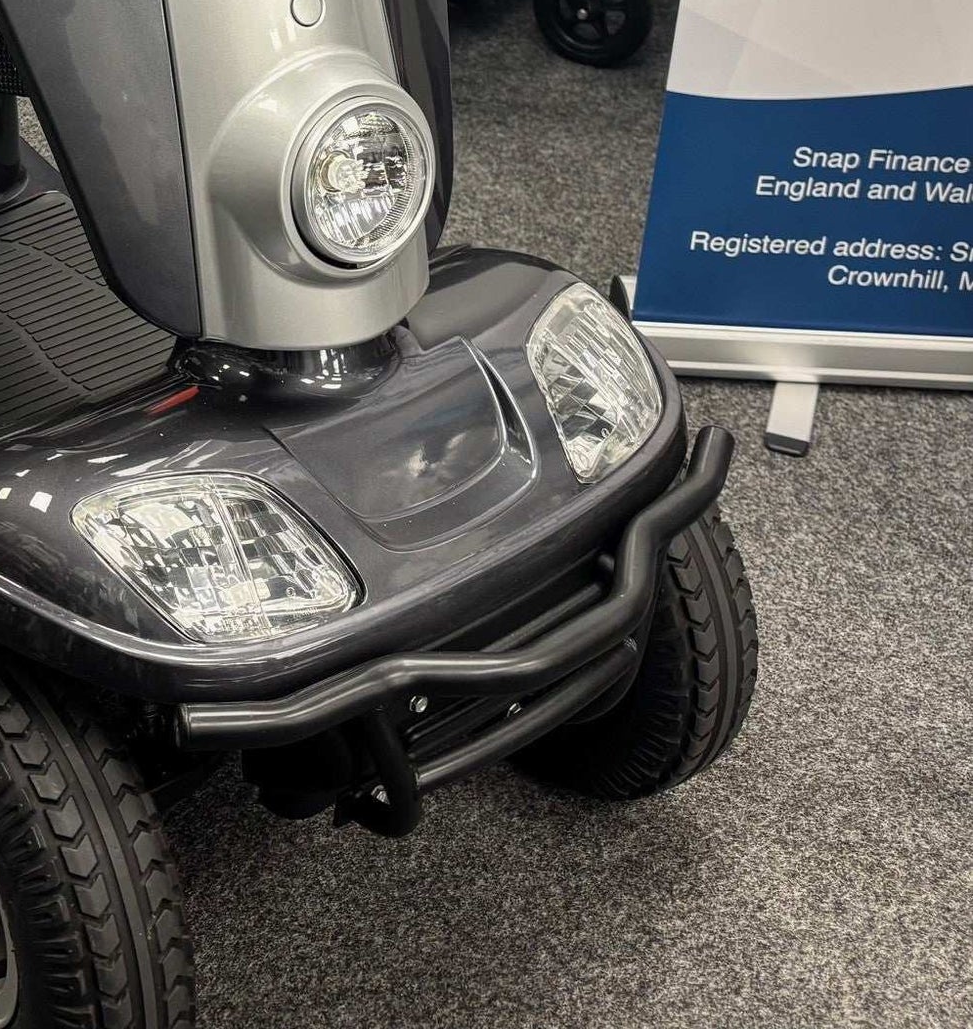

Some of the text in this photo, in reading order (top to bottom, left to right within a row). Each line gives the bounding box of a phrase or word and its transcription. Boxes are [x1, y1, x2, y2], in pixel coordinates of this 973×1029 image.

[793, 146, 971, 174] Snap Finance
[755, 175, 973, 205] England and Wal
[689, 230, 973, 264] Registered address: S
[827, 264, 949, 293] Crownhill,
